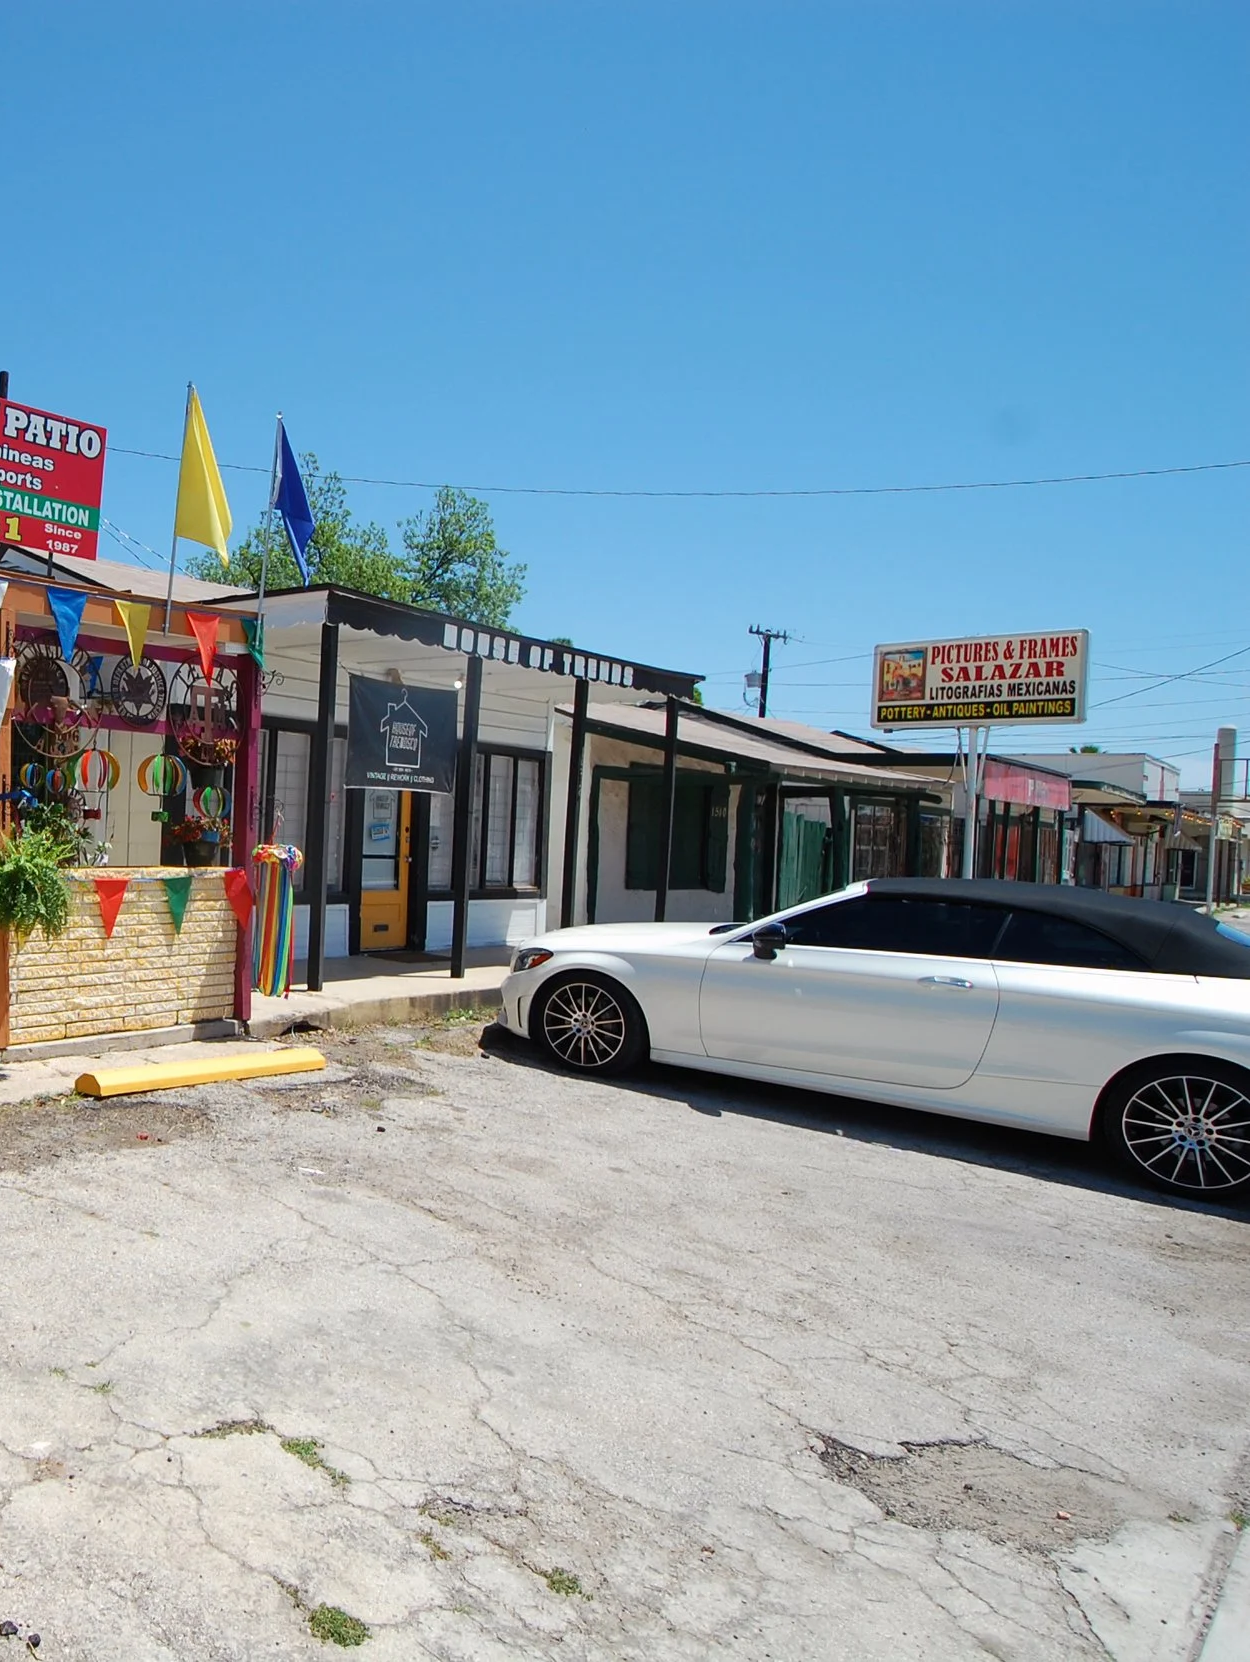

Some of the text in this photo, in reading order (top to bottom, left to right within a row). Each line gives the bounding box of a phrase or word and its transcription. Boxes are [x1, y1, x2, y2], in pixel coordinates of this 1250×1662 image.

[3, 406, 102, 460] PATIO
[44, 523, 82, 540] Since
[46, 540, 79, 554] 1987
[931, 636, 1078, 665] PICTURES & FRAMES
[941, 660, 1065, 683] SALAZAR
[930, 680, 1076, 700] LITOGRAFIAS MEXICANAS
[881, 703, 926, 719] POTTERY
[932, 703, 985, 718] ANTIQUES
[993, 704, 1009, 717] OIL
[1012, 700, 1071, 716] PAINTINGS
